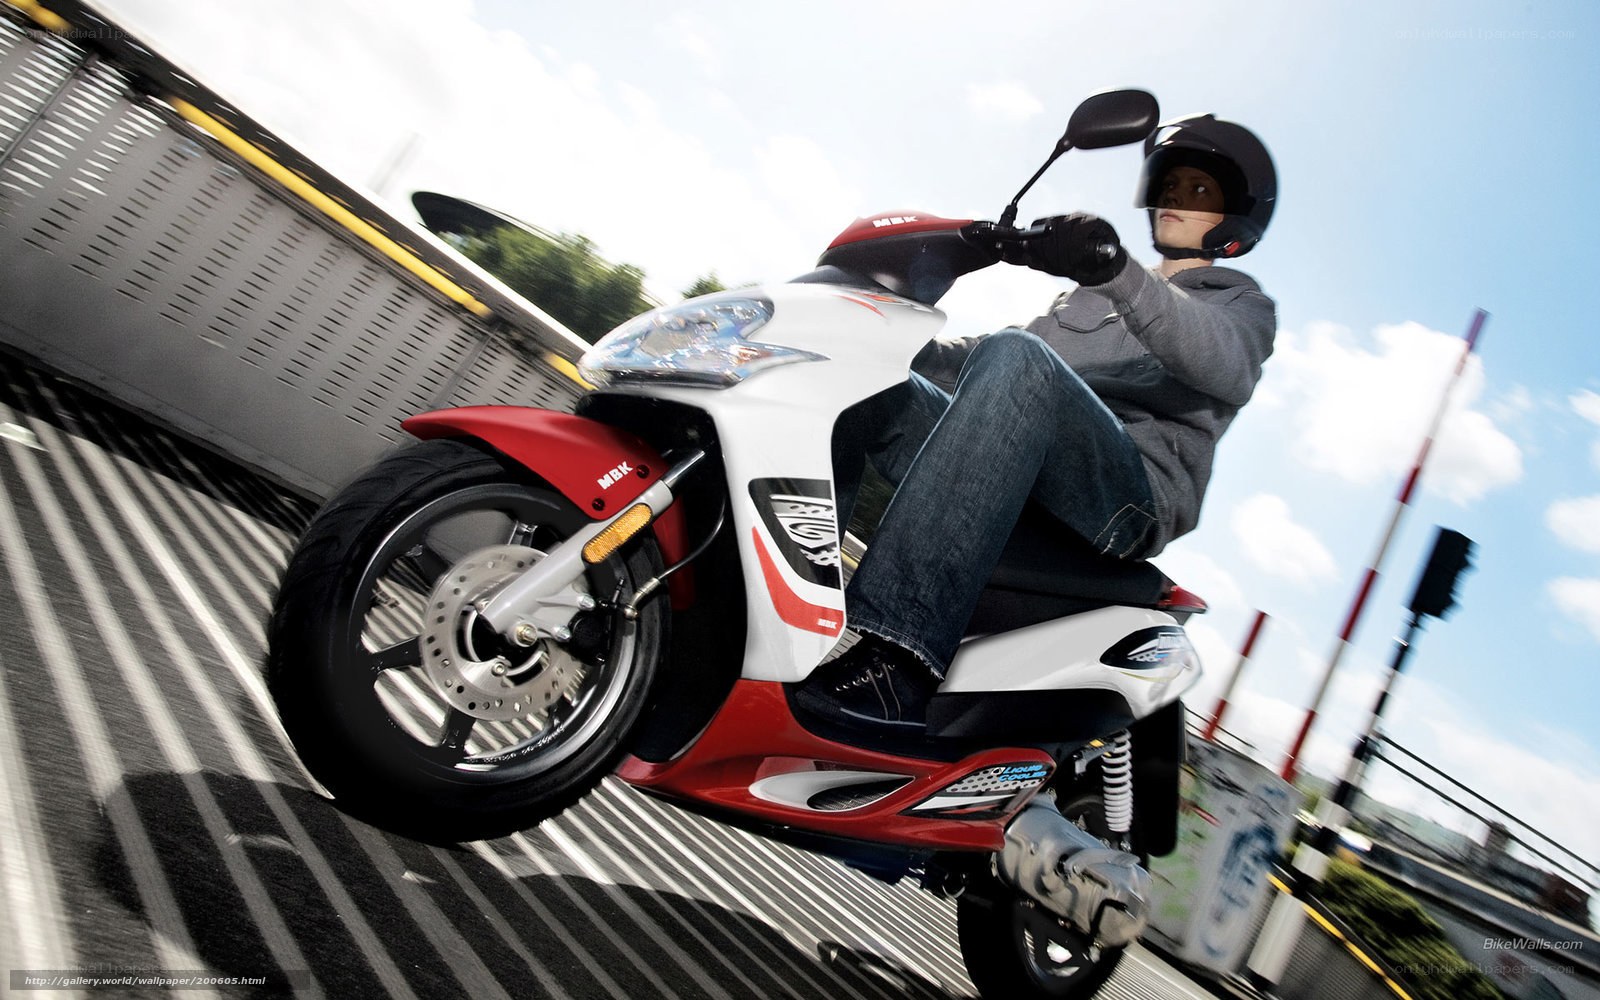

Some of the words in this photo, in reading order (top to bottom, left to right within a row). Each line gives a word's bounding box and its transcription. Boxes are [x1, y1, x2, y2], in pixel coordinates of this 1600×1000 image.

[597, 461, 633, 490] MBK
[1003, 764, 1043, 775] LIQUID
[998, 771, 1047, 782] COOLED
